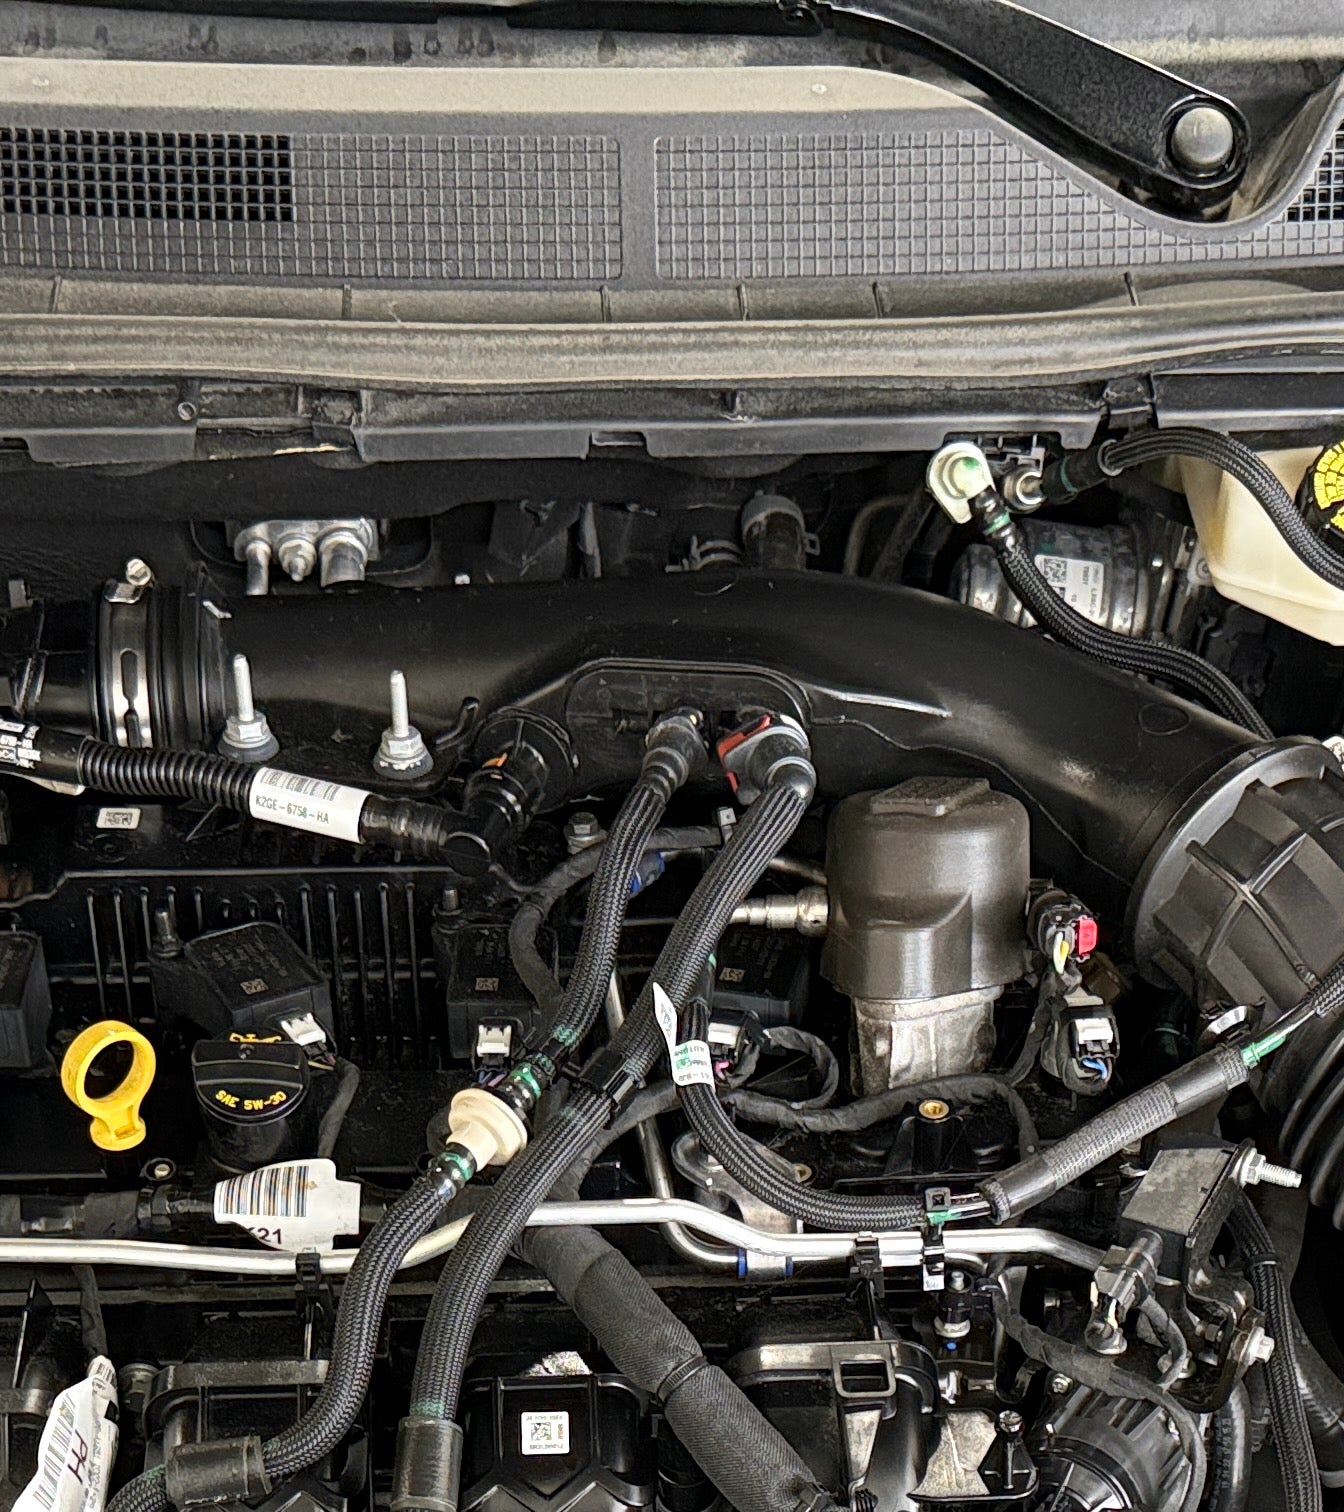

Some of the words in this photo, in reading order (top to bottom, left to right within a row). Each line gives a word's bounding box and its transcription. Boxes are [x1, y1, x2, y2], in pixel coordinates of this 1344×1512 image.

[215, 1090, 240, 1108] SAE
[243, 1091, 287, 1111] 5W-30
[247, 1227, 283, 1246] 21
